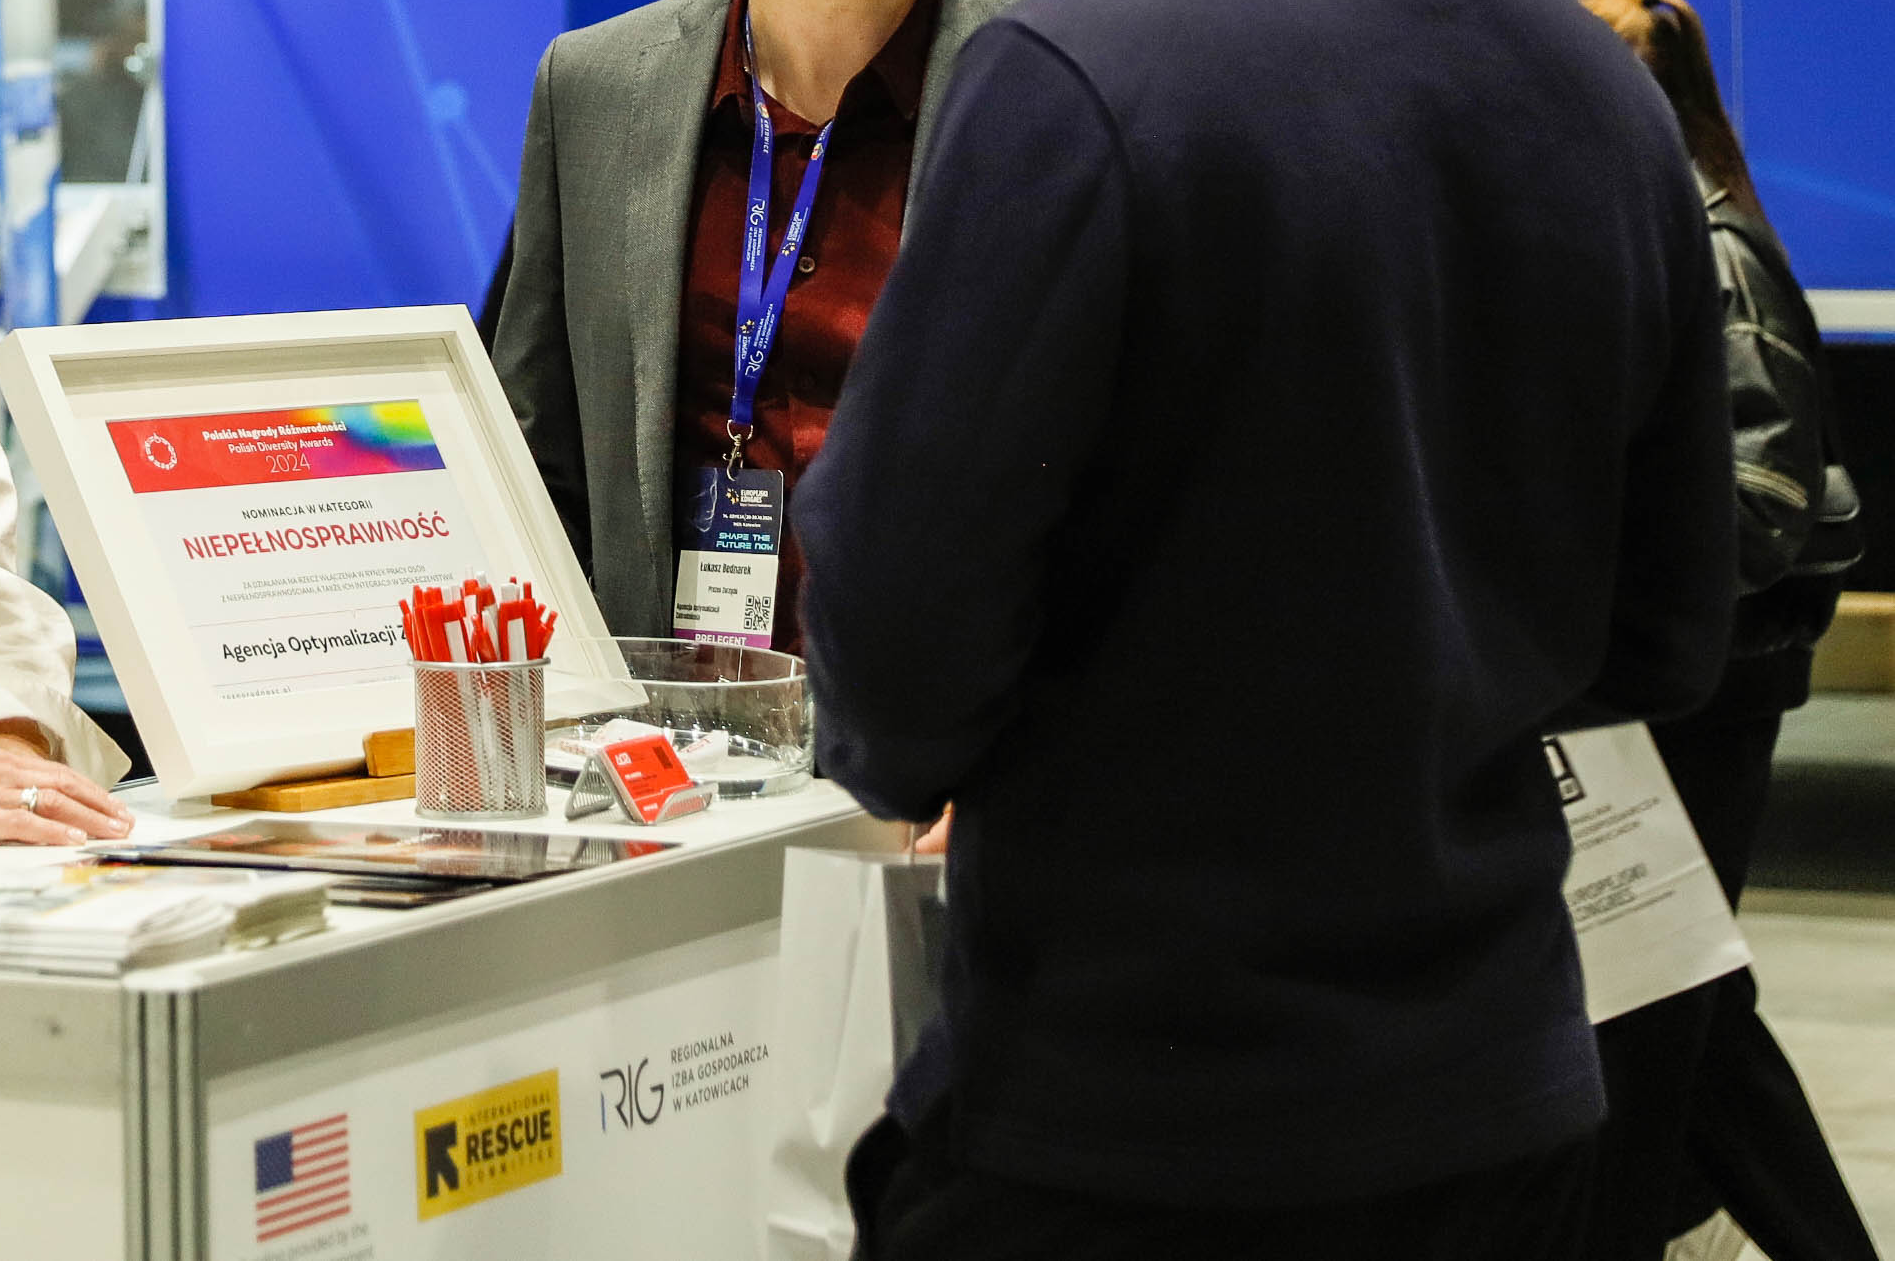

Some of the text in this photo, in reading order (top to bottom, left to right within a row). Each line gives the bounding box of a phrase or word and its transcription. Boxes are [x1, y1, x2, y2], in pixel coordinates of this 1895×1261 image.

[201, 420, 348, 442] Polskie Nagrody Różnorodności
[227, 437, 334, 455] Polish Diversity Awards
[265, 452, 312, 474] 2024
[241, 499, 374, 520] NOMINACJA W KATEGORII
[183, 510, 451, 560] NIEPEŁNOSPRAWNOŚĆ
[716, 540, 752, 550] FUTURE
[718, 532, 771, 542] SHAPE THE
[222, 636, 287, 663] Agencja
[287, 624, 398, 656] Optymalizacji
[694, 633, 747, 646] PRELEGENT
[670, 1031, 735, 1064] REGIONALNA
[671, 1043, 769, 1089] IZBA GOSPODARCZA
[599, 1056, 665, 1134] RIG
[672, 1074, 750, 1113] W KATOWICACH
[465, 1109, 553, 1166] RESCUE
